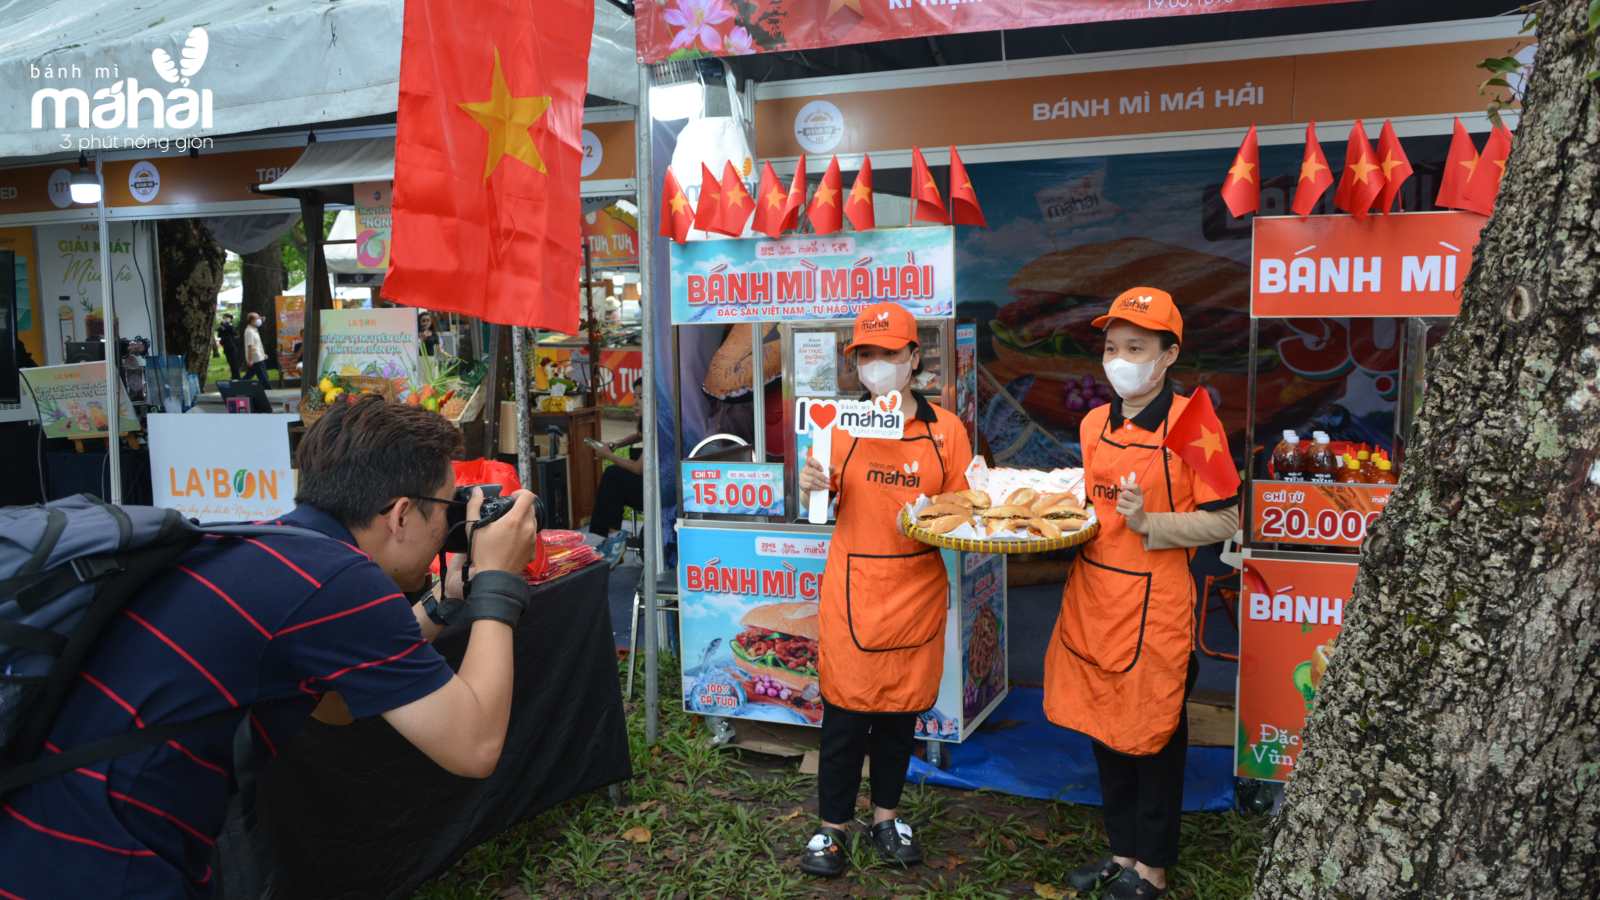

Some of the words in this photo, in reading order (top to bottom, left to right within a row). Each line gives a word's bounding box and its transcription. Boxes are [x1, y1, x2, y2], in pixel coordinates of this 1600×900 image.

[1033, 97, 1110, 121] BÁNH
[1119, 91, 1150, 114] MÌ
[1160, 86, 1205, 112] MÁ
[1215, 82, 1264, 108] HẢI
[686, 263, 772, 305] BÁNH
[776, 258, 818, 304] MÌ
[820, 255, 873, 302] MÁ
[875, 250, 935, 299] HẢI
[1259, 244, 1382, 294] BÁNH
[1401, 241, 1461, 292] MÌ
[782, 305, 805, 315] NAM
[799, 401, 805, 431] I
[169, 466, 279, 500] LA'BON
[692, 482, 773, 508] 15.000
[686, 556, 759, 596] BÁNH
[762, 559, 797, 598] MÌ
[1249, 585, 1344, 625] BÁNH
[1260, 723, 1300, 749] Đặc
